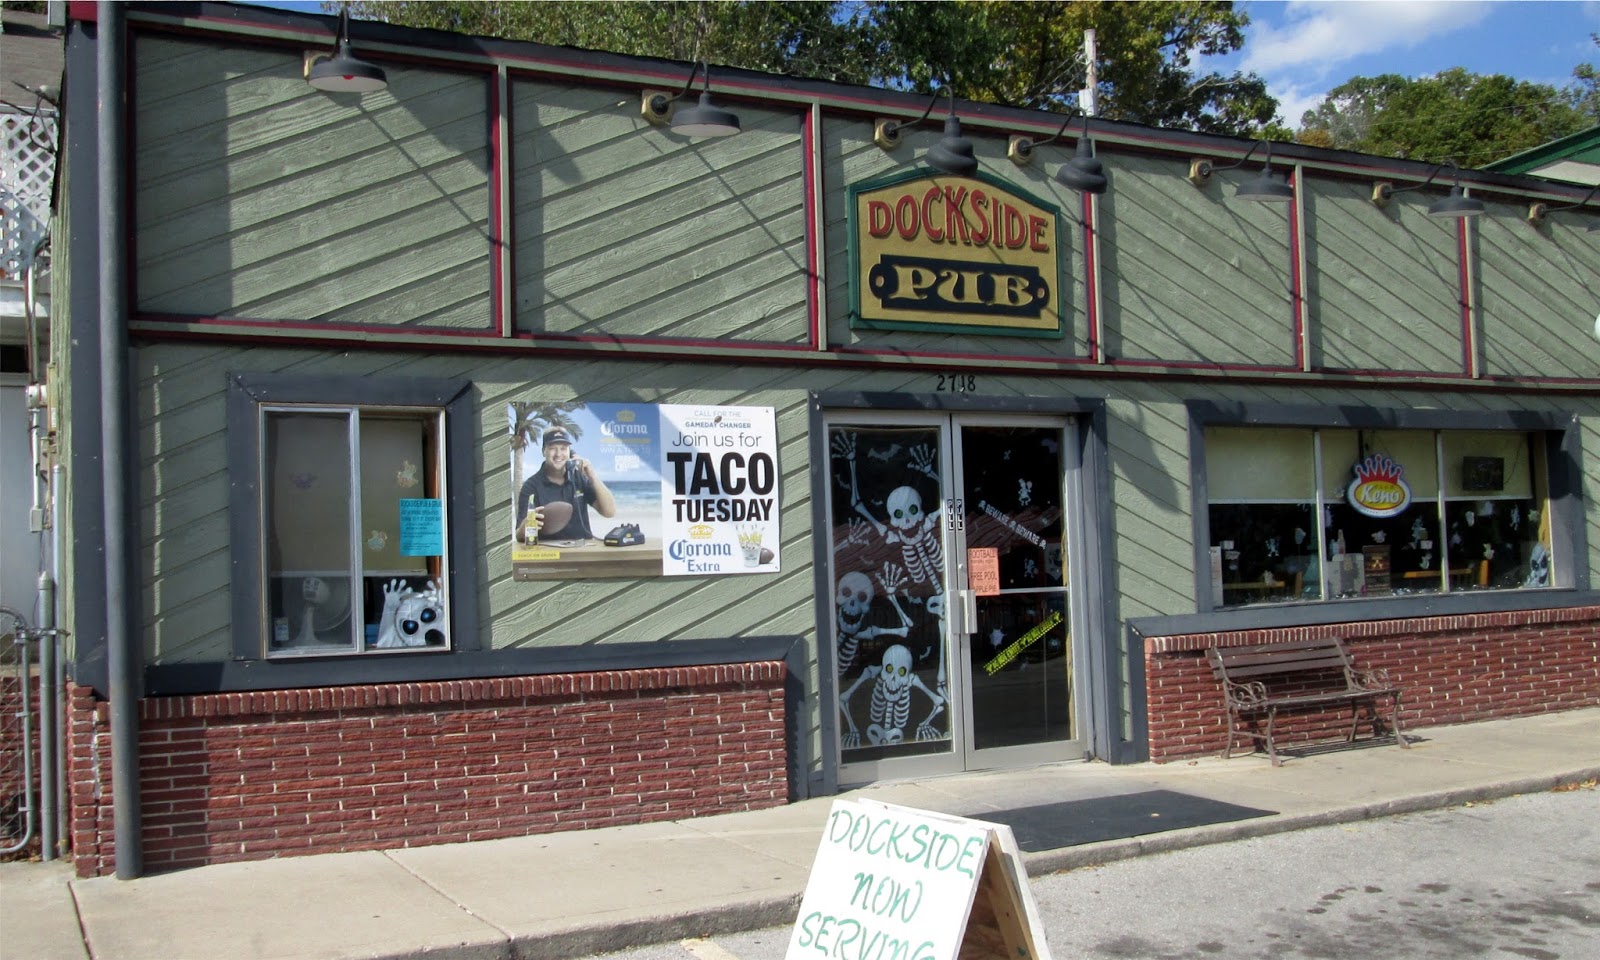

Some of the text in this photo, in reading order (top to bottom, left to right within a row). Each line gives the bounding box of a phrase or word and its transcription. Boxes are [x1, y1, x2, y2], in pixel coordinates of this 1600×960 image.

[868, 185, 1049, 251] DOCKSIDE
[889, 264, 1034, 307] PUB
[600, 420, 648, 438] Corona
[672, 431, 762, 447] Join us for
[667, 452, 774, 495] TACO
[1360, 484, 1401, 504] Keno
[672, 498, 774, 523] TUESDAY
[985, 504, 1040, 545] BEWARE BEWARE
[669, 539, 732, 563] Corona
[687, 559, 721, 572] Extra
[970, 571, 983, 580] FREE
[830, 809, 984, 879] DOCKSIDE
[850, 872, 923, 923] NOW
